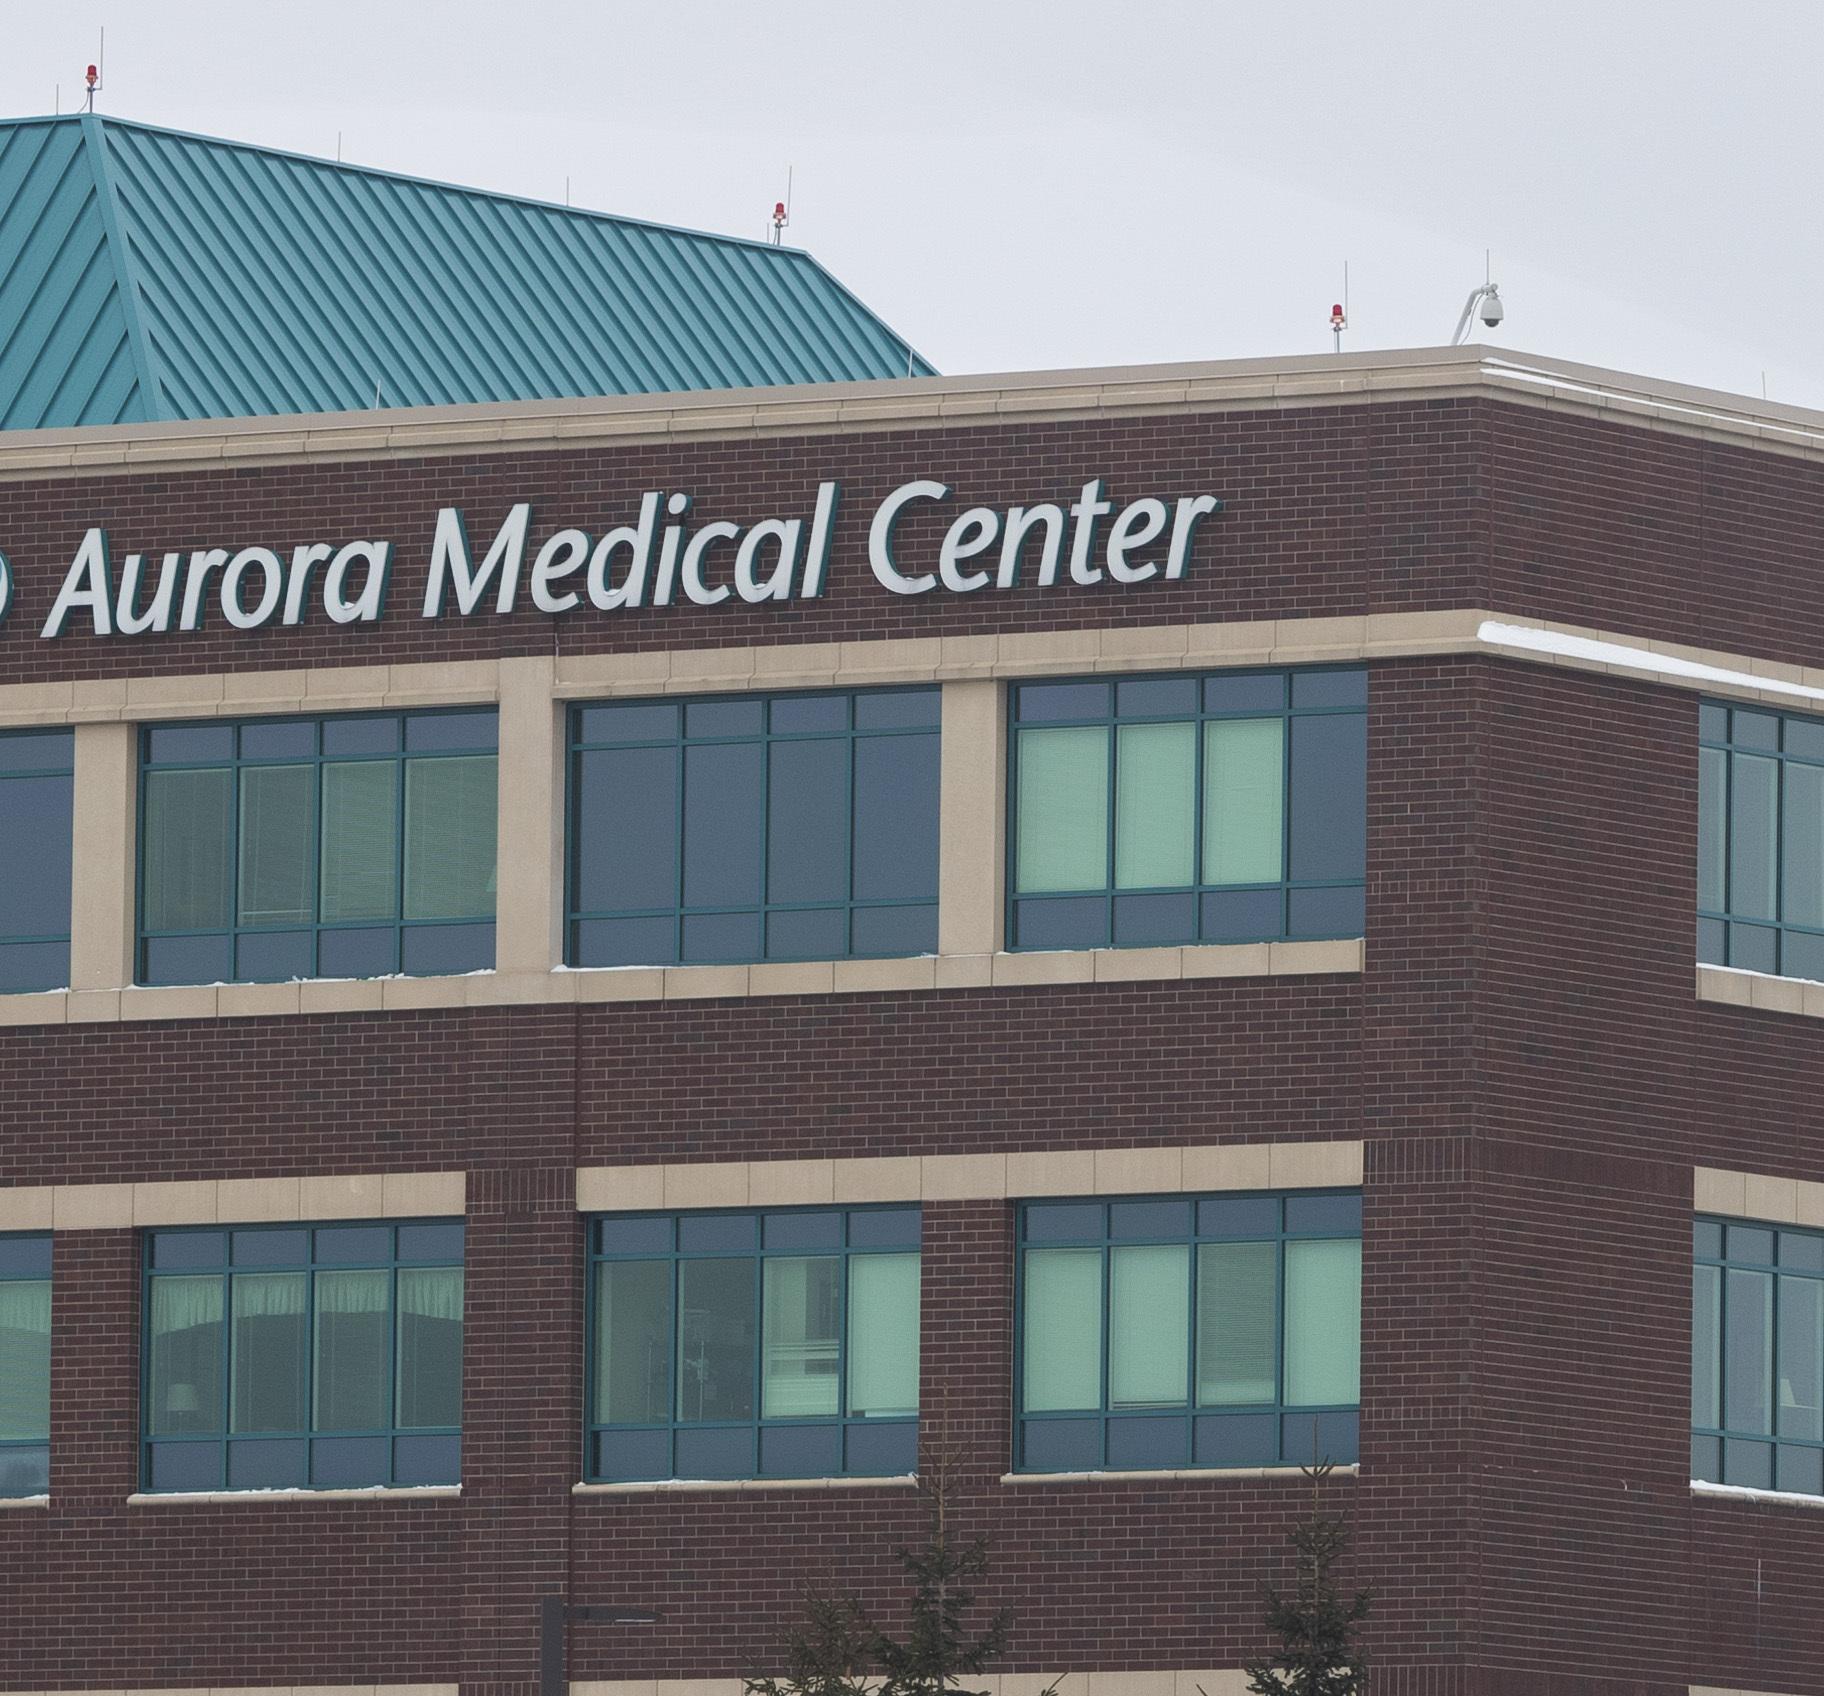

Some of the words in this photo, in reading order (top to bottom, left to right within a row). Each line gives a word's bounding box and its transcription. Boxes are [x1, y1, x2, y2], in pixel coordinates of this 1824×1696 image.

[39, 526, 392, 638] Aurora
[420, 480, 838, 618] Medical
[867, 478, 1220, 595] Center
